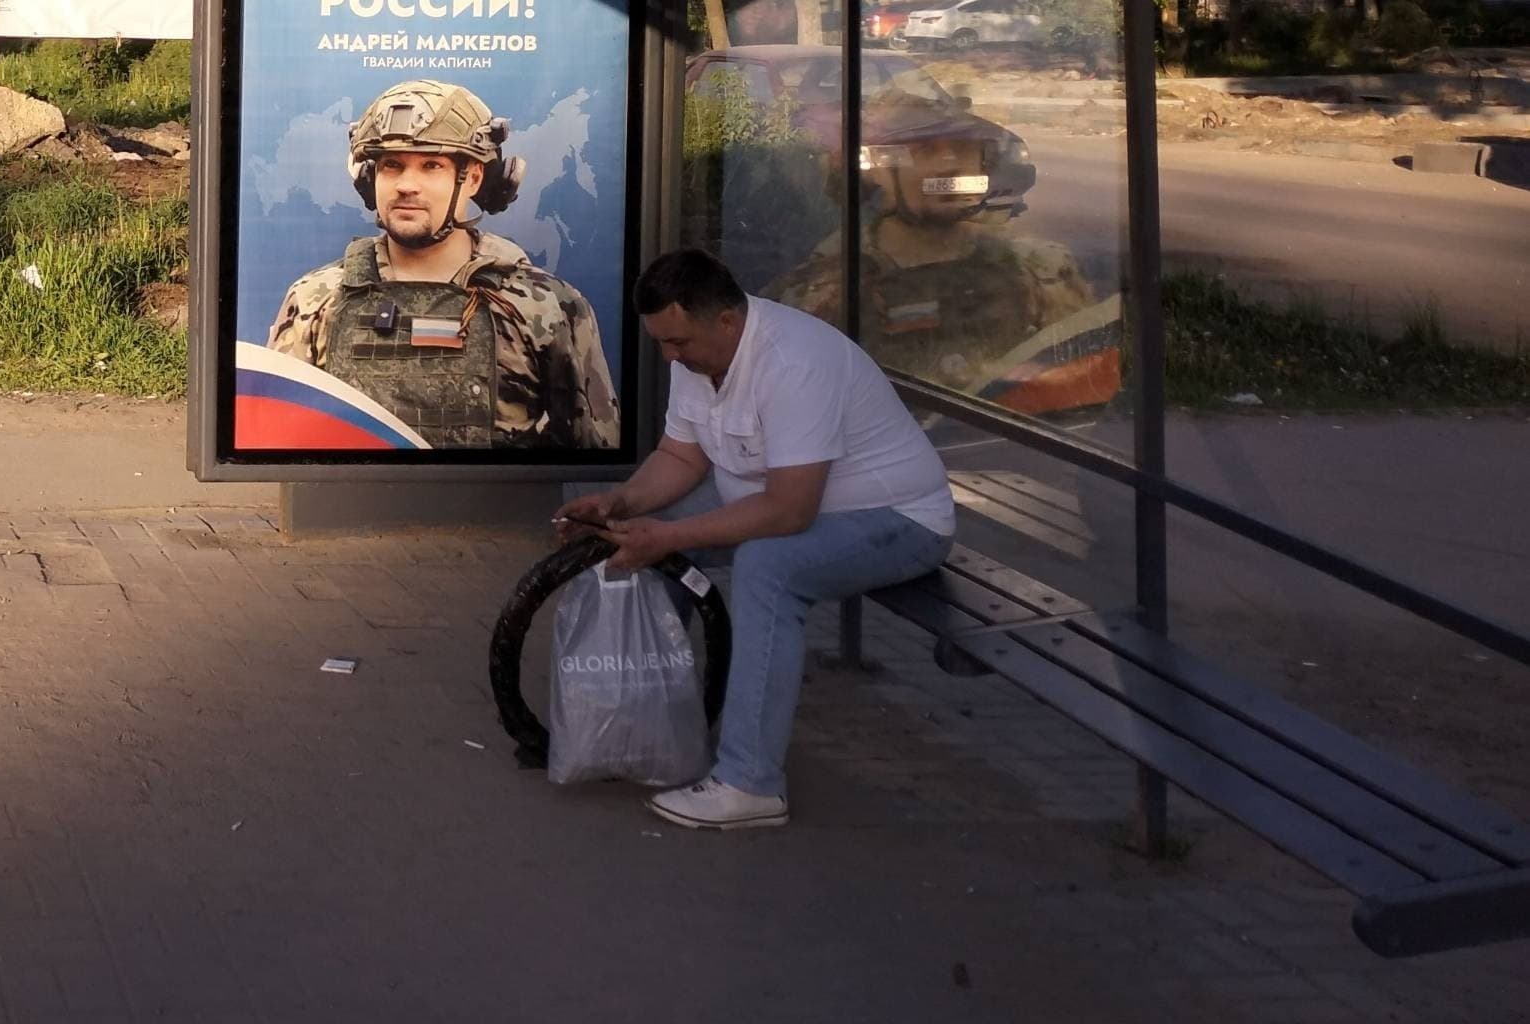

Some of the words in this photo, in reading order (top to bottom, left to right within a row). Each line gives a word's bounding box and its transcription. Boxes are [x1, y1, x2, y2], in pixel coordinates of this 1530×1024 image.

[317, 29, 409, 53] АНДРЕЙ
[416, 34, 538, 52] МАРКЕЛОВ
[362, 56, 424, 69] ГВАРДИИ
[428, 57, 492, 69] КАПИТАН
[559, 654, 636, 673] GLORIA
[642, 649, 695, 671] JEANS
